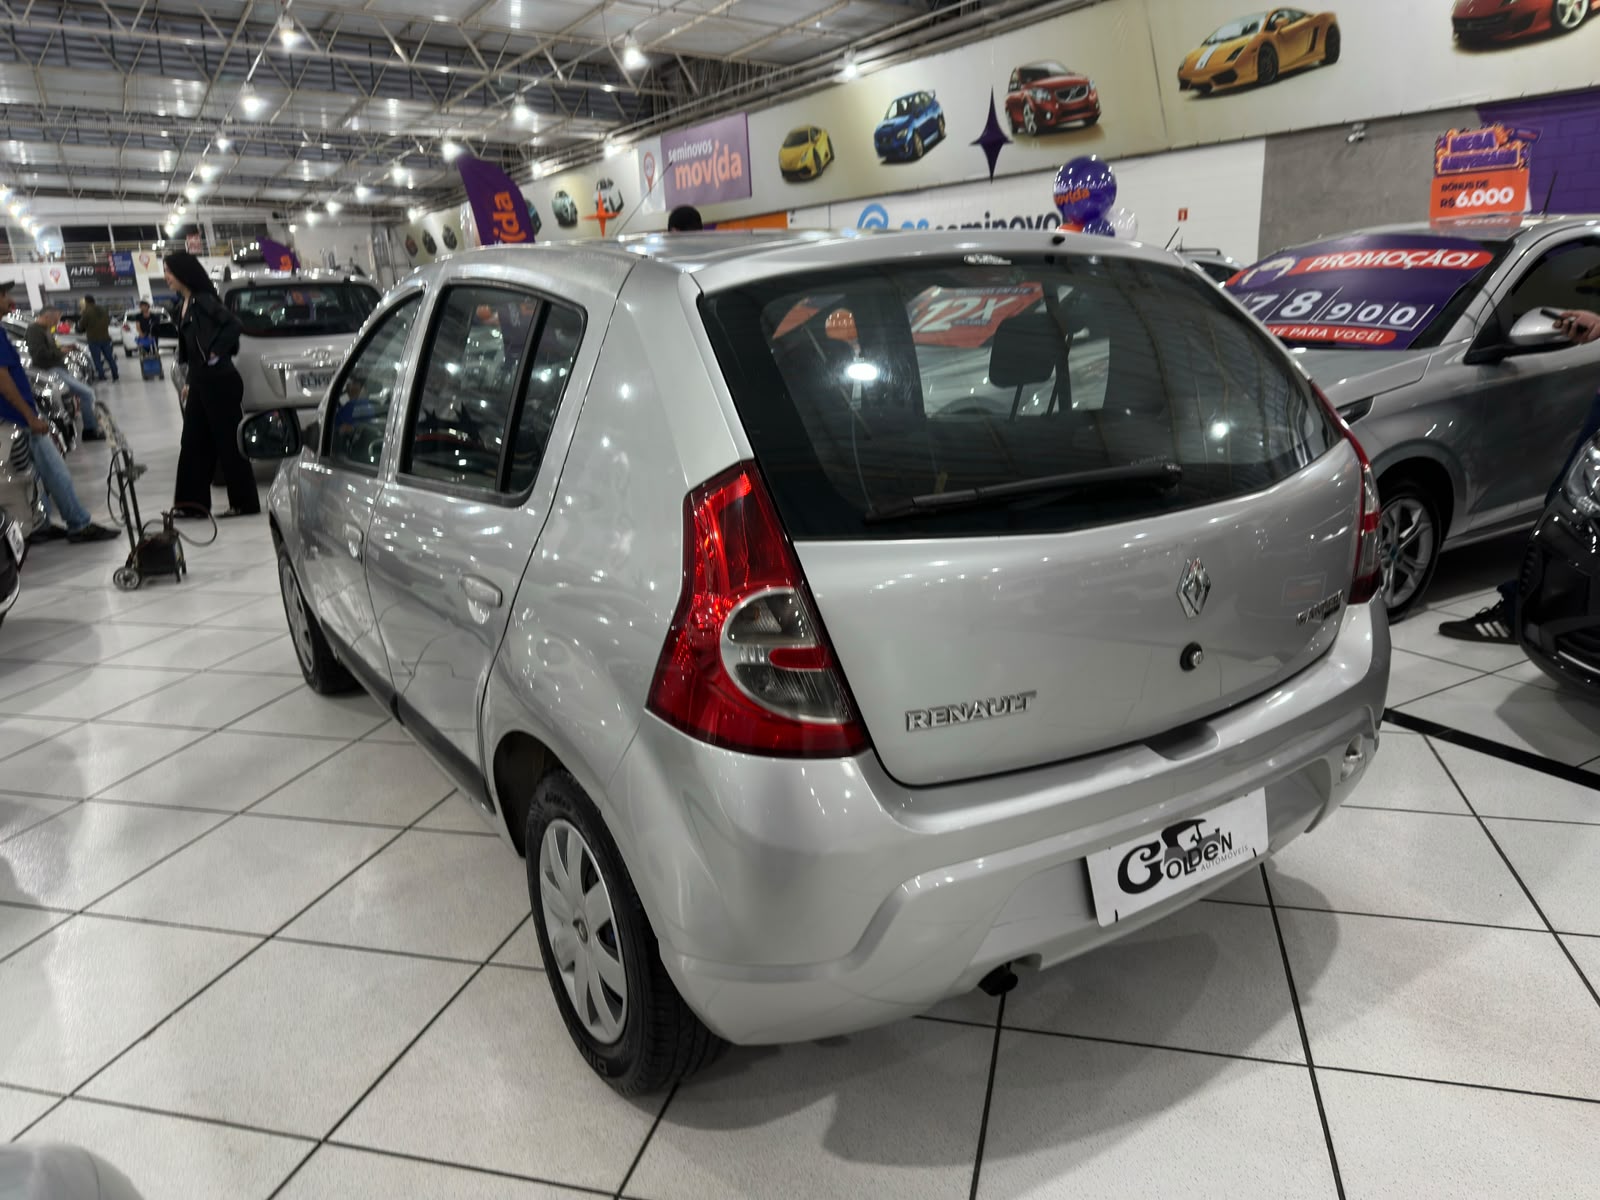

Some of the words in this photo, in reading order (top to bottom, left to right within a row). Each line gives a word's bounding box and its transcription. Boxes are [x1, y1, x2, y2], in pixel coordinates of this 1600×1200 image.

[668, 139, 713, 162] seminovos
[675, 139, 743, 191] movida
[1053, 187, 1091, 206] ovida
[1455, 186, 1515, 208] 6.000
[493, 191, 527, 243] ida
[1306, 249, 1480, 270] PROMOÇÃO!
[1289, 327, 1328, 339] PARA
[1333, 327, 1385, 342] VOCÊ!
[905, 690, 1037, 732] RENAULT
